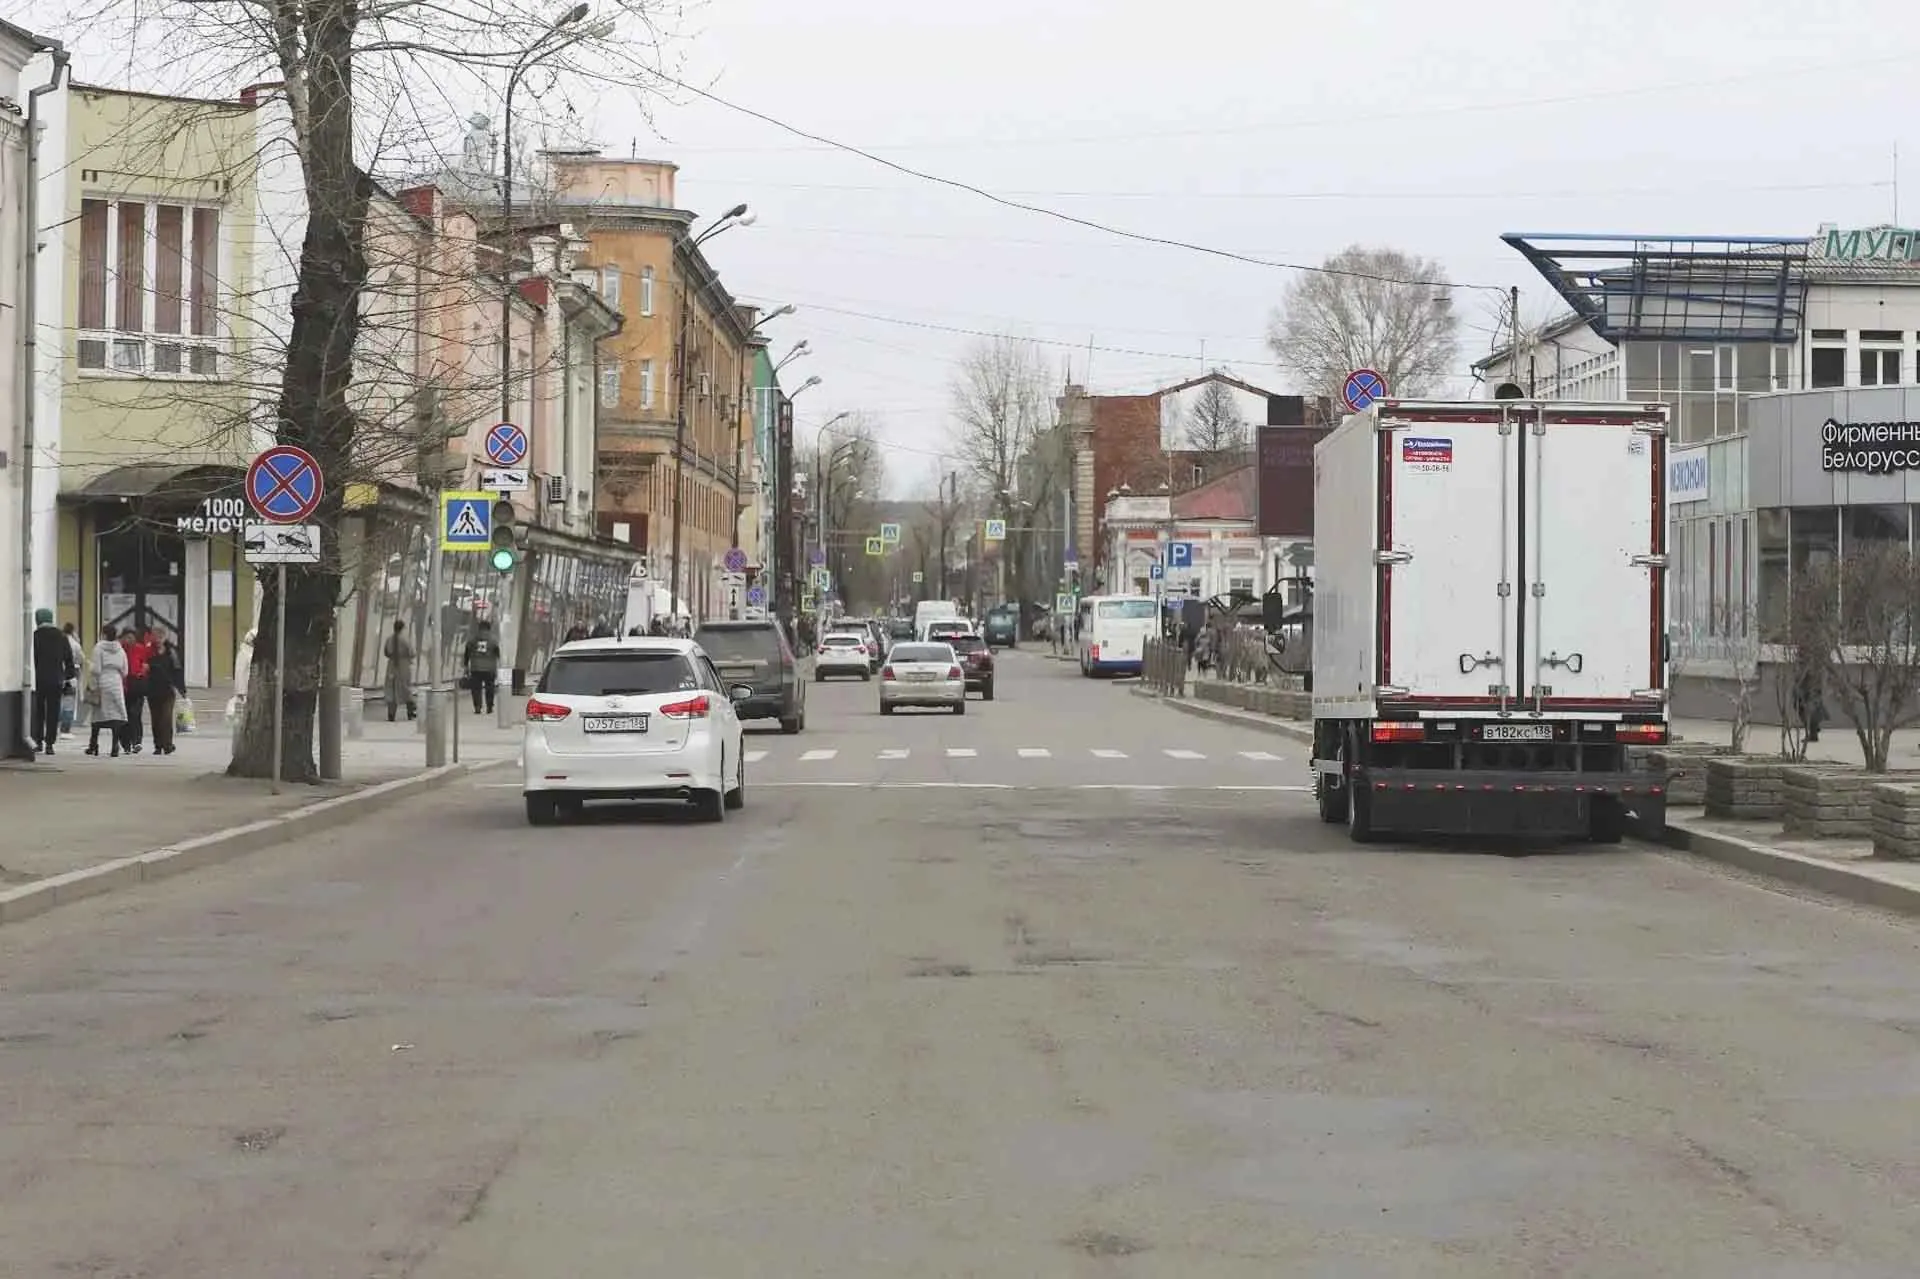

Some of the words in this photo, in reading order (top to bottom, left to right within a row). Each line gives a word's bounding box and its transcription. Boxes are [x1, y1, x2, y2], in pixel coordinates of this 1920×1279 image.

[1823, 447, 1920, 472] Белорусс
[203, 498, 245, 517] 1000
[176, 516, 272, 533] мелоч
